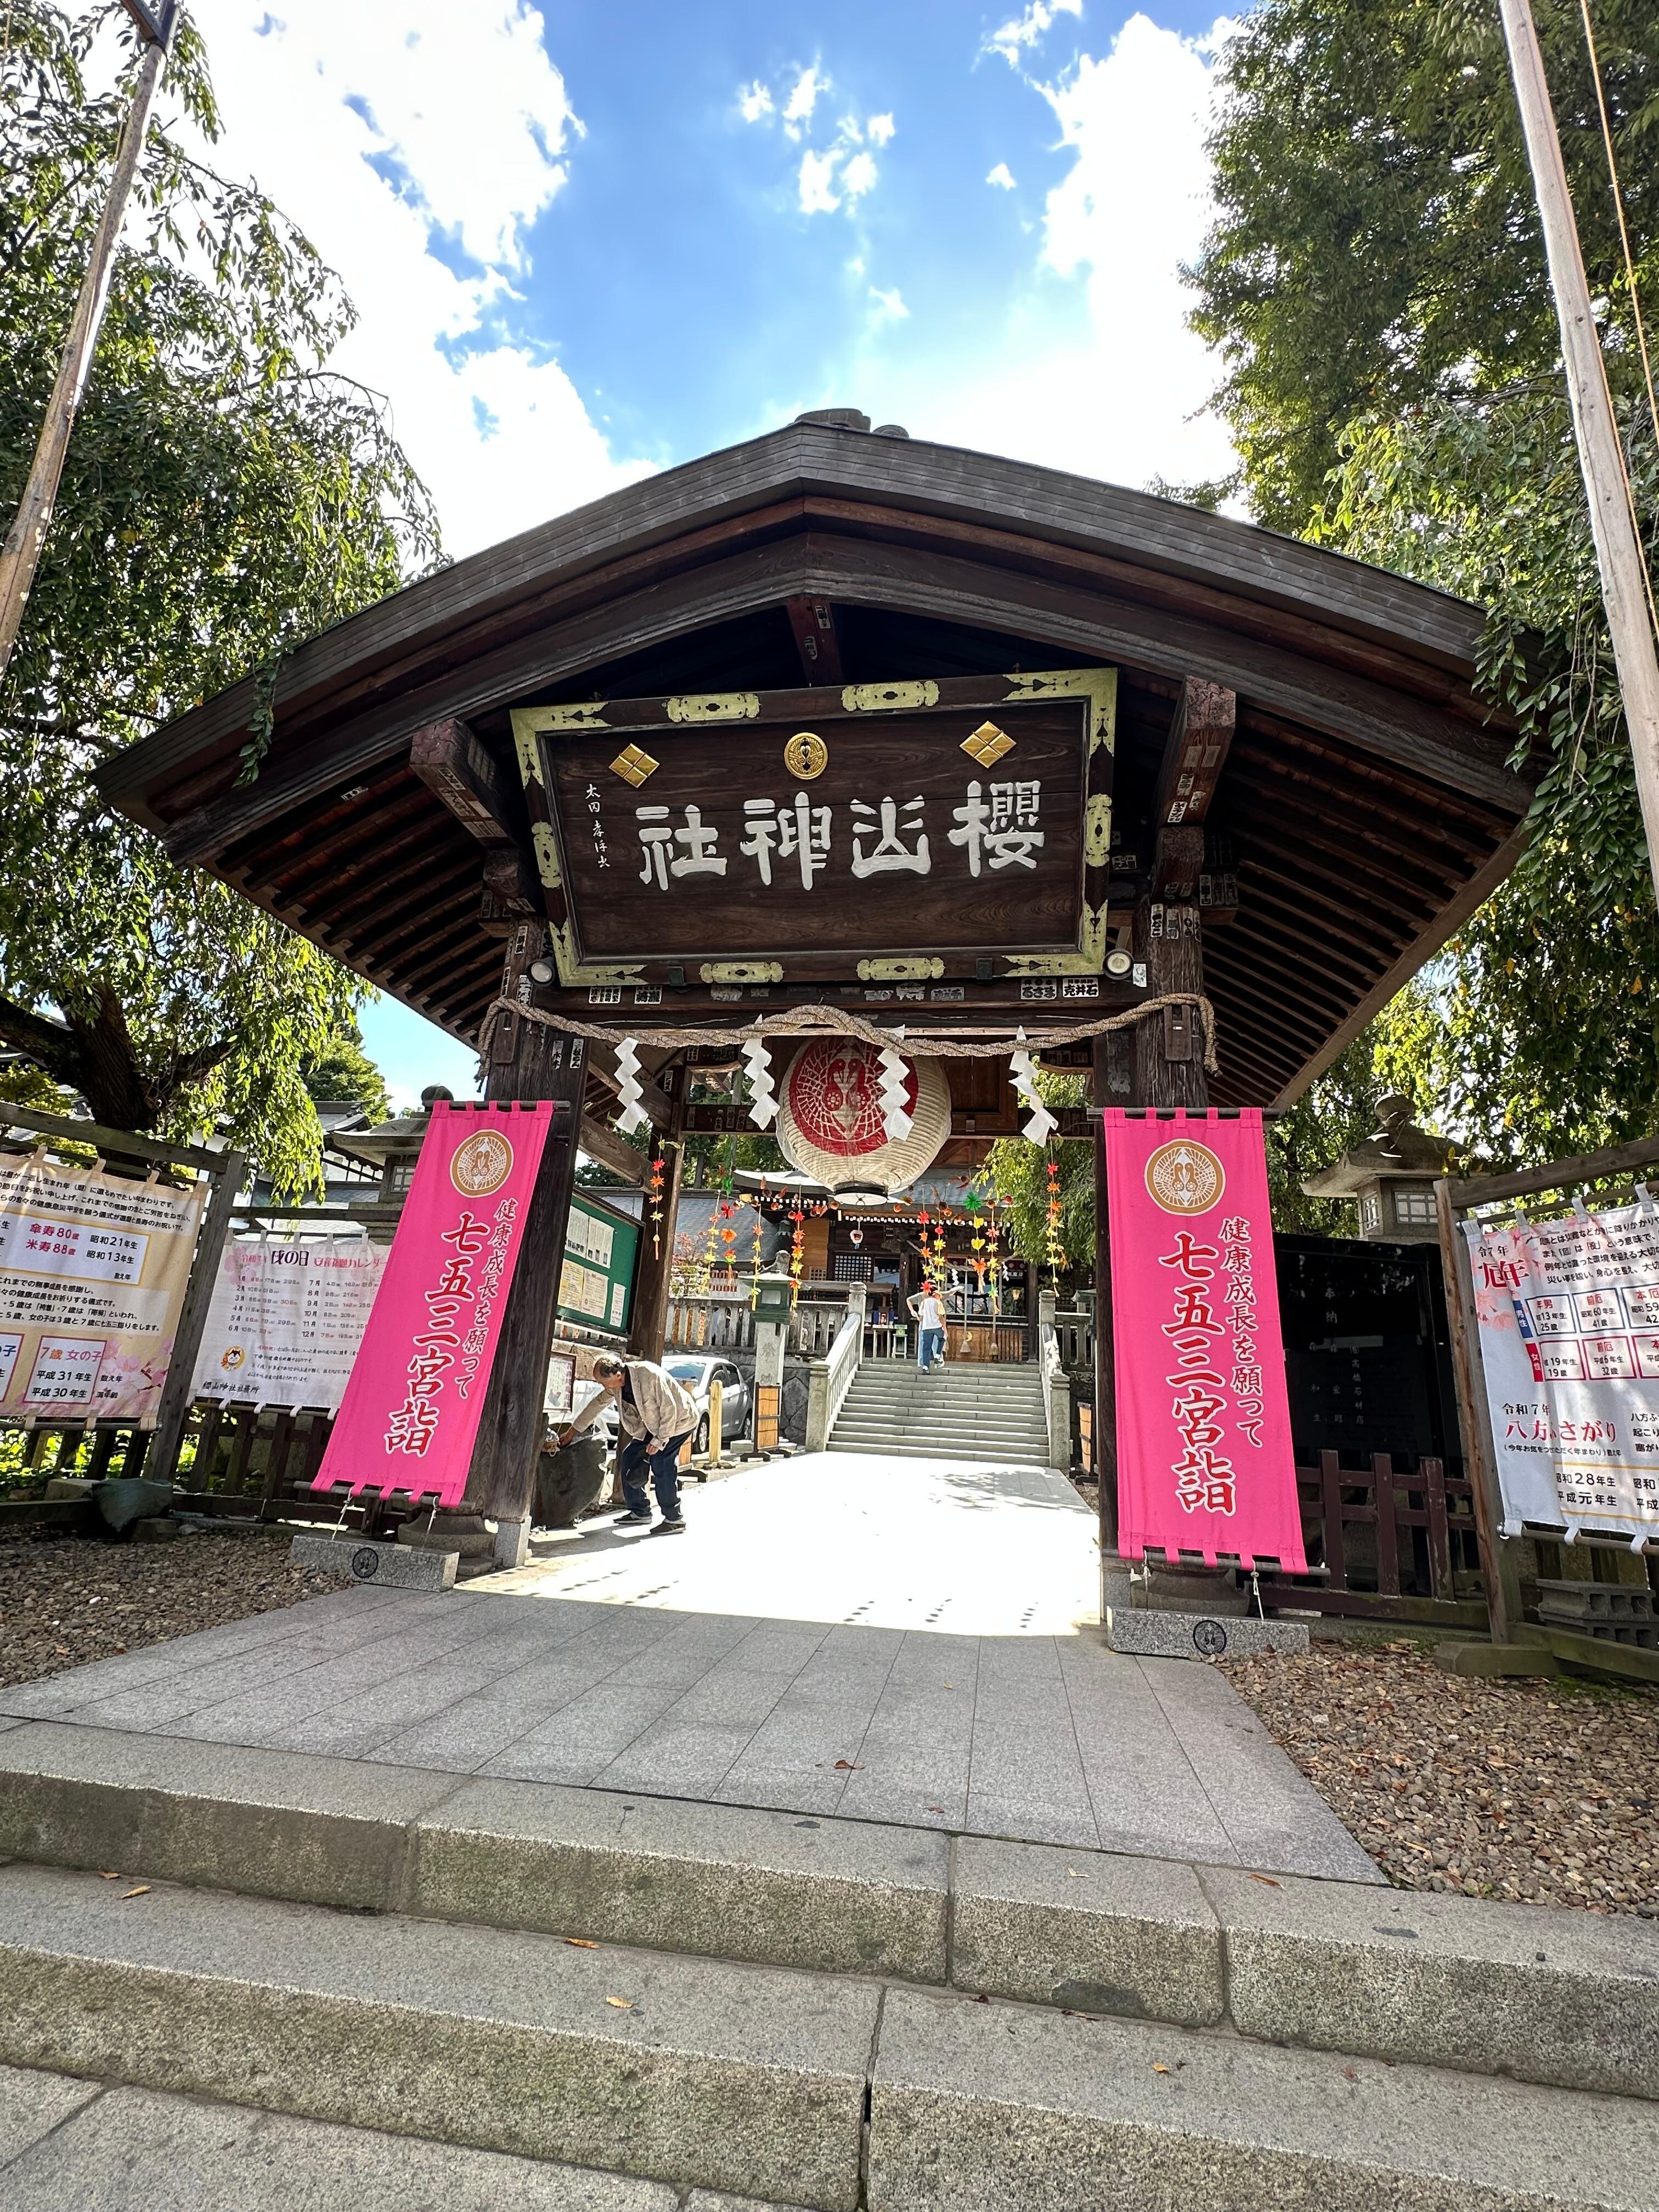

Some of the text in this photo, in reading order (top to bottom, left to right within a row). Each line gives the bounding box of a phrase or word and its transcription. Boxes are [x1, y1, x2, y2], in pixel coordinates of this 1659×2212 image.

[90, 1234, 138, 1249] 昭和21年生
[26, 1239, 134, 1264] 米寿88歳 昭和13年生
[454, 1198, 519, 1400] 健康成長を願って
[384, 1211, 492, 1458] 七五三宮詣
[1218, 1216, 1263, 1448] 健康成長を願って
[66, 1350, 101, 1362] 女の子
[1531, 1353, 1542, 1370] 女性
[37, 1370, 92, 1382] 平成31年生
[1159, 1229, 1237, 1516] 七五三宮詣
[32, 1387, 88, 1398] 平成30年生
[1502, 1403, 1550, 1415] 令和7年
